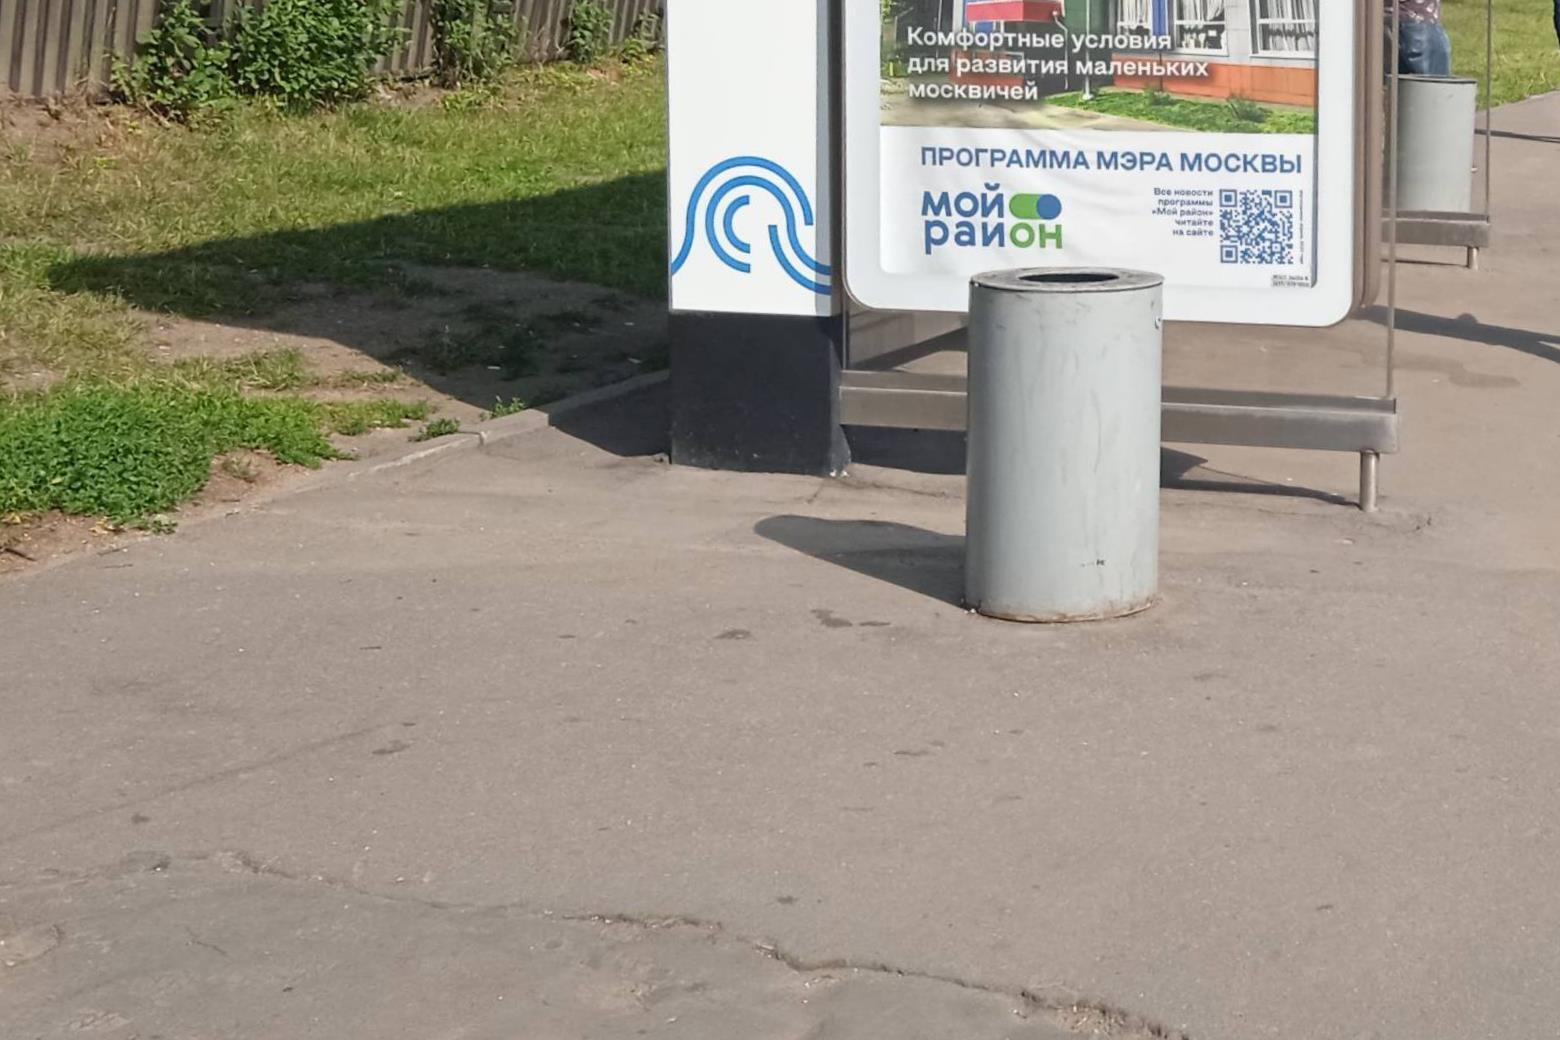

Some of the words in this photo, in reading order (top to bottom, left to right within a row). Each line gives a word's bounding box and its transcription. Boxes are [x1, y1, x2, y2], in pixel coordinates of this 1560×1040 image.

[907, 27, 1065, 51] Комфортные
[1072, 34, 1172, 53] условия
[907, 56, 949, 74] для
[956, 58, 1068, 77] развития
[1076, 61, 1208, 77] маленьких
[909, 81, 1038, 100] москвичей
[921, 146, 1090, 169] ПРОГРАММА
[1097, 151, 1173, 172] МЭРА
[1180, 153, 1302, 174] МОСКВЫ
[921, 182, 1005, 218] мой
[1154, 187, 1172, 196] Все
[1158, 199, 1213, 208] программы
[1186, 227, 1214, 236] сайте
